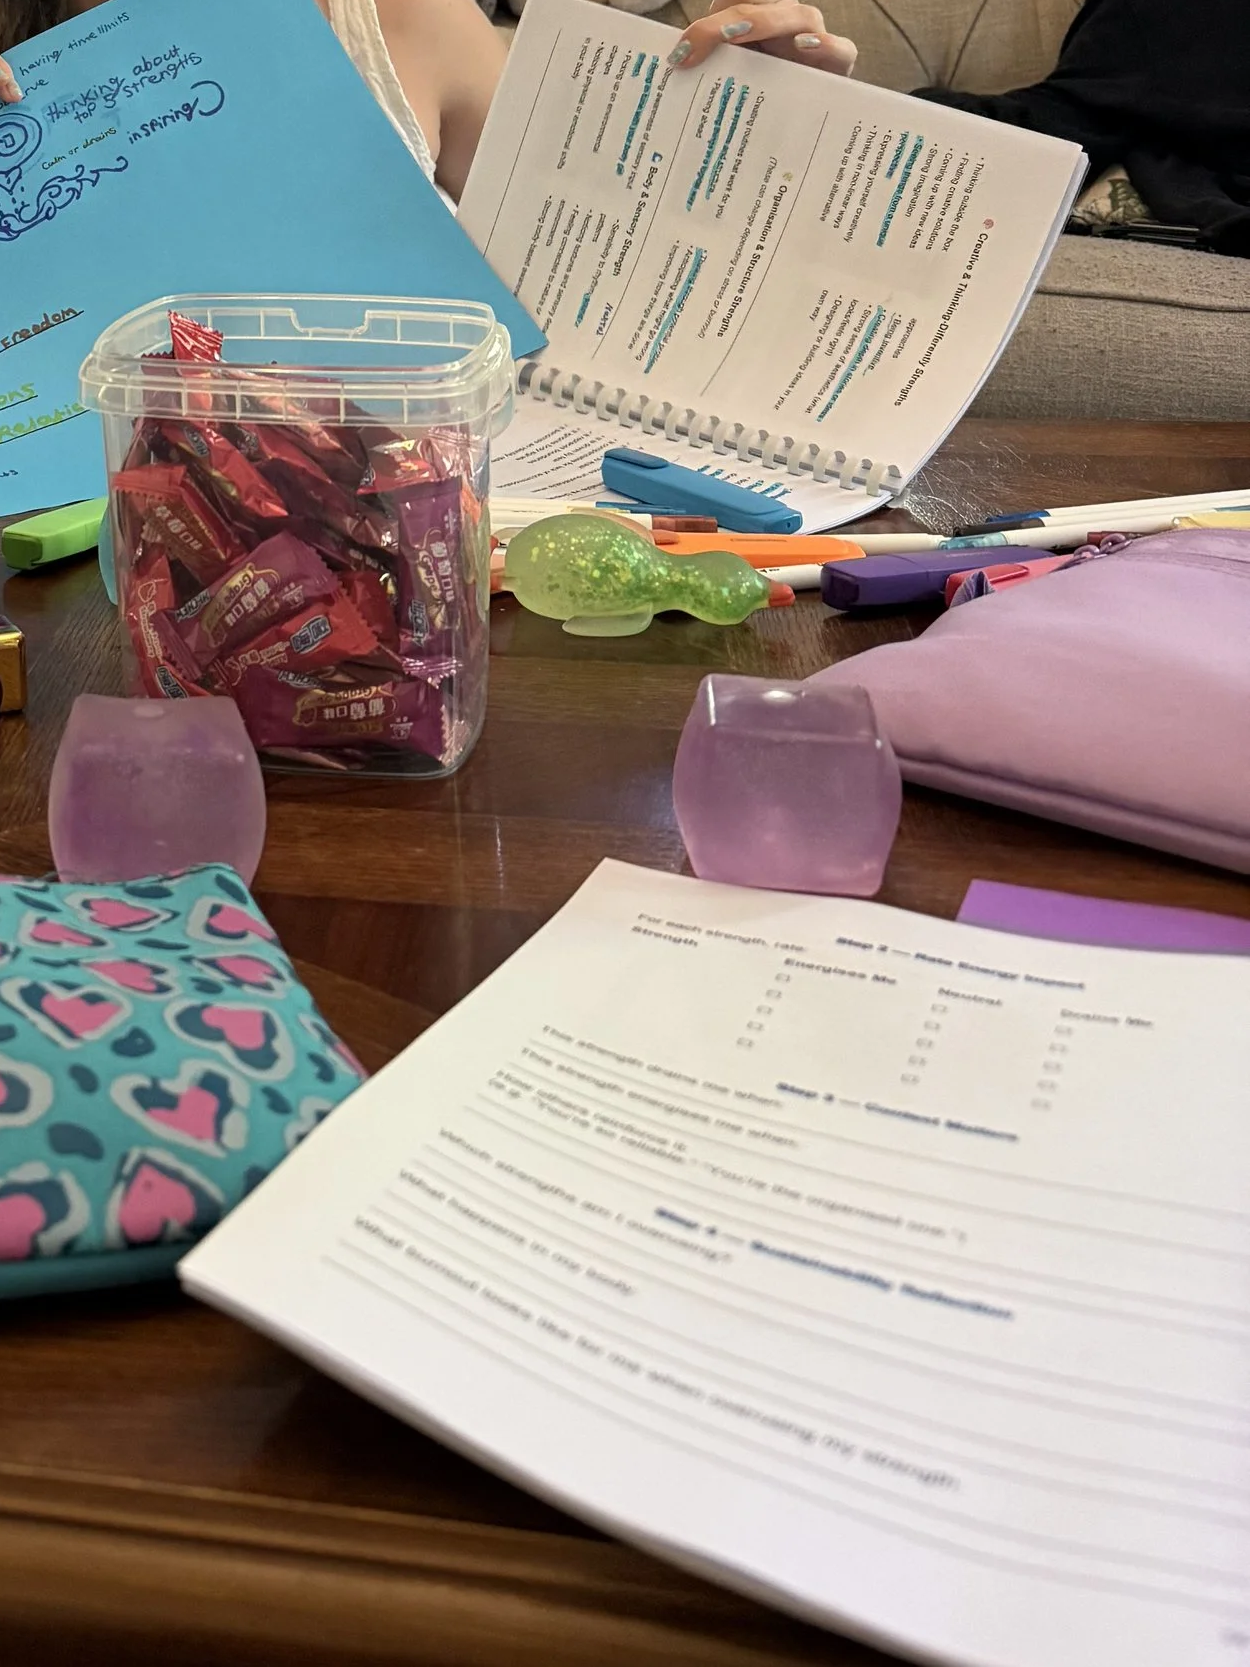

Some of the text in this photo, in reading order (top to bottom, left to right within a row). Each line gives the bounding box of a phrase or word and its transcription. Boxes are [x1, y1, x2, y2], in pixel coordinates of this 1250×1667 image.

[46, 45, 180, 123] thinking about
[73, 103, 96, 124] top
[104, 93, 117, 110] 5
[856, 129, 876, 161] Thinking
[819, 124, 861, 222] Coming up with alternative
[854, 162, 863, 170] in
[902, 147, 937, 217] Strong imagination
[720, 192, 730, 203] for
[842, 133, 891, 243] Expressing yourself creatively
[888, 194, 901, 213] from
[908, 151, 952, 249] Coming up with new ideas
[925, 156, 968, 250] Finding creative solutions
[610, 165, 657, 277] Body & Sensory Strength
[713, 204, 724, 218] you
[830, 209, 844, 228] ways
[941, 161, 983, 252] Thinking outside the box
[715, 184, 788, 338] Organisation & Structure Strengths
[964, 231, 989, 270] Creative
[960, 271, 971, 280] &
[817, 298, 842, 334] Designing
[852, 308, 870, 333] Strong
[798, 344, 819, 371] building
[837, 355, 847, 363] of
[893, 368, 924, 407] Strengths
[222, 572, 253, 604] Grape
